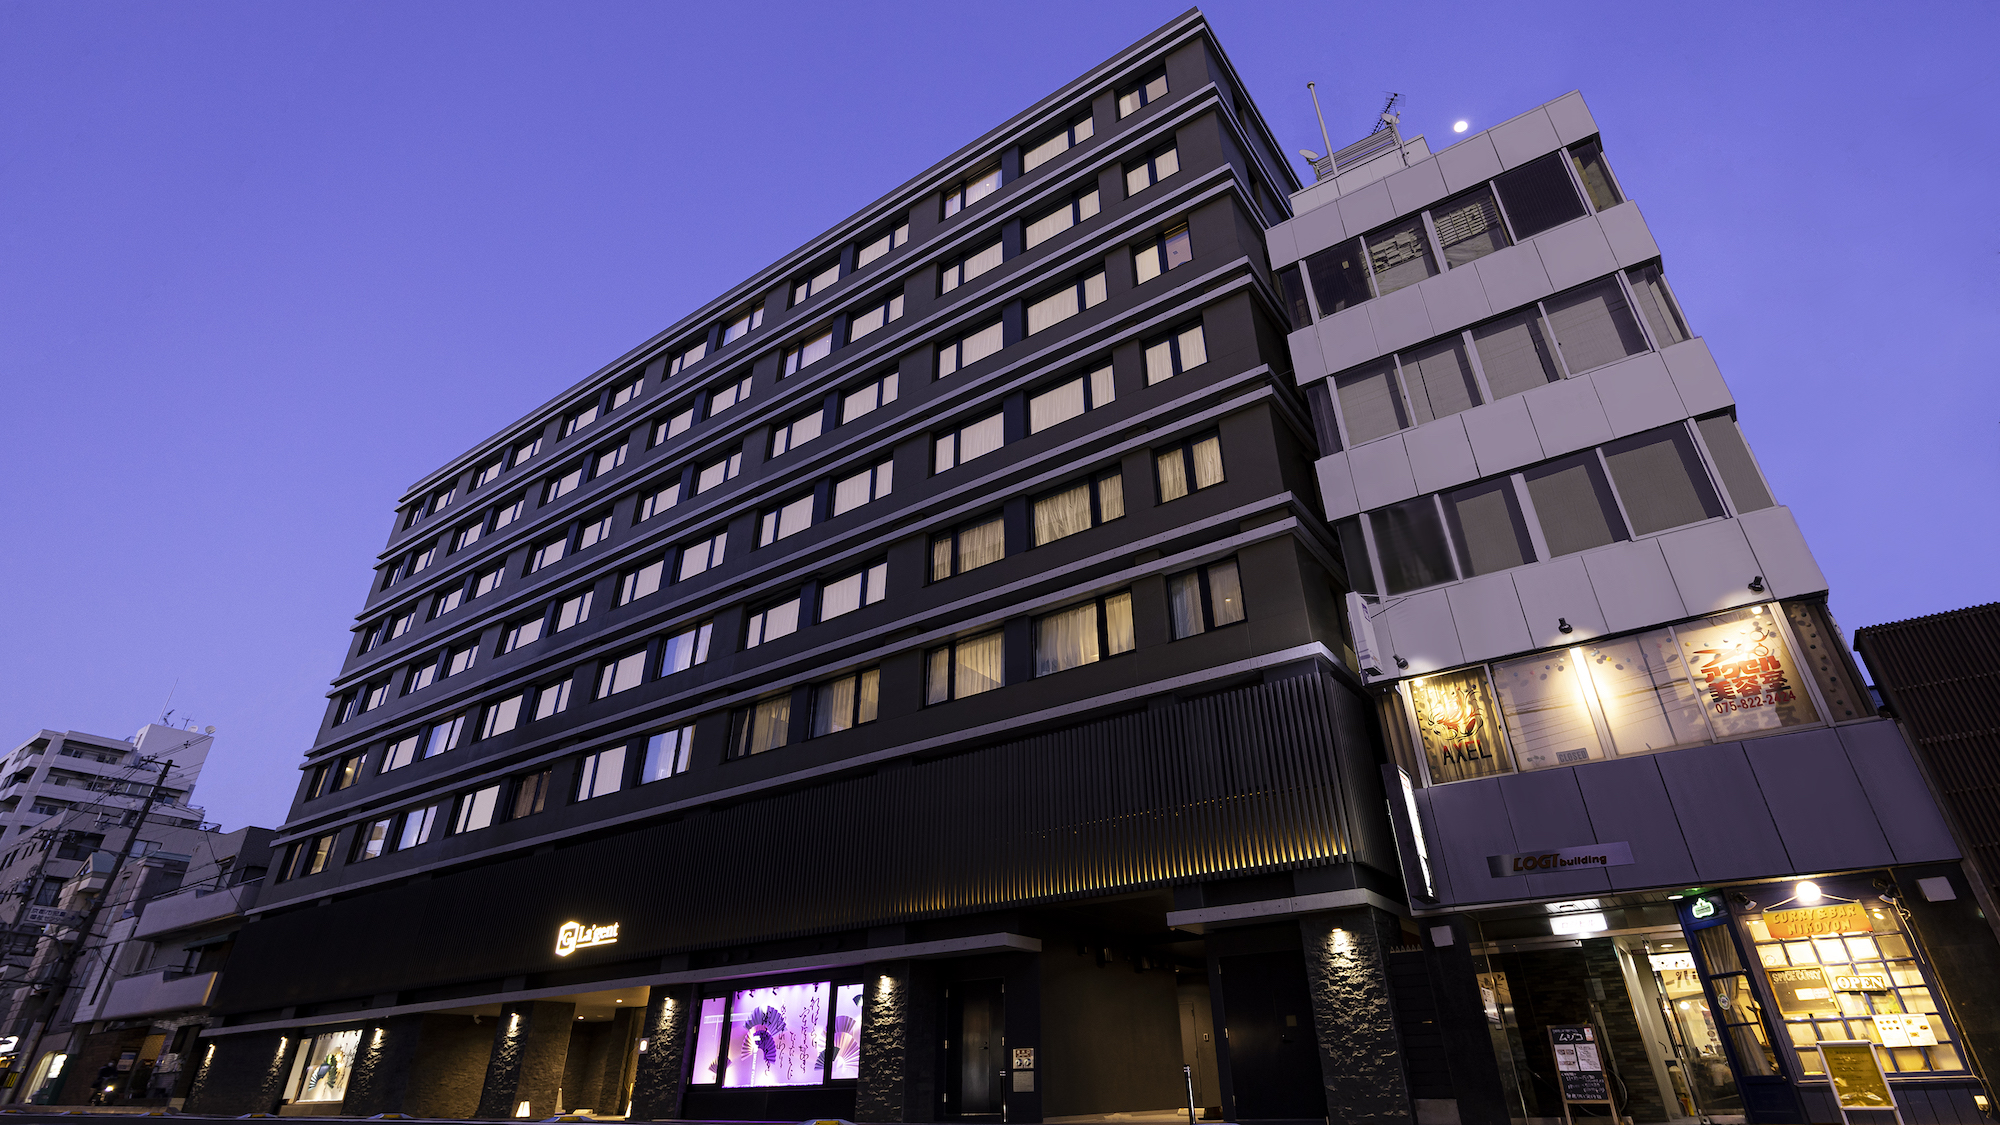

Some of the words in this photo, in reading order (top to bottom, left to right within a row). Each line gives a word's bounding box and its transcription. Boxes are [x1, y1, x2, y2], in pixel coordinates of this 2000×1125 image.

[1701, 655, 1781, 683] アクセル
[1708, 670, 1791, 703] 美容室
[1715, 690, 1796, 714] 075-822-2424
[1443, 739, 1493, 765] AXEL
[1559, 751, 1588, 763] CLOSED
[1513, 853, 1560, 872] LOGI
[1560, 855, 1607, 867] building
[577, 922, 619, 943] La'gent
[1788, 920, 1851, 935] NIKOYON
[1837, 976, 1885, 989] OPEN
